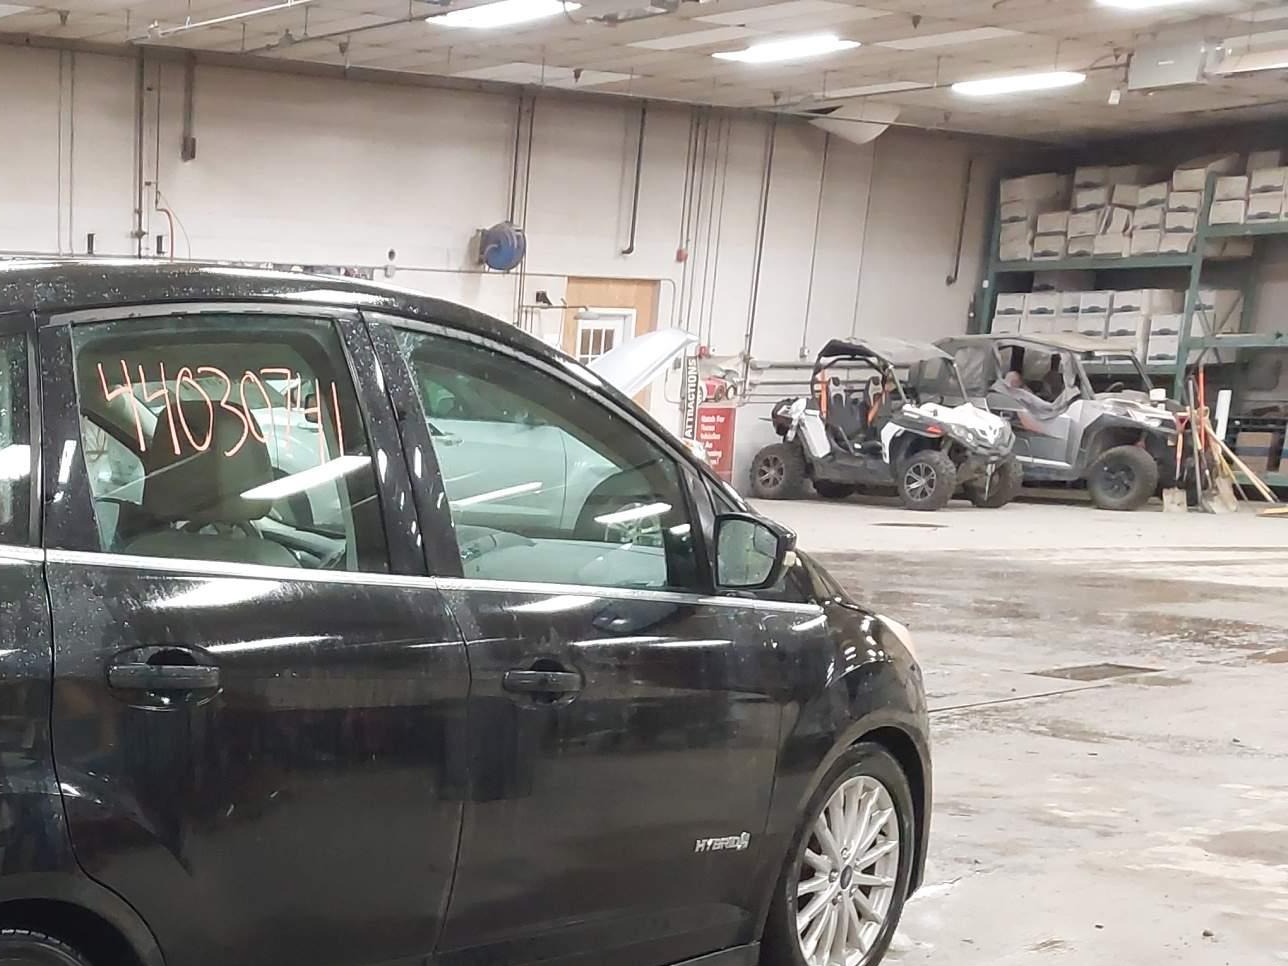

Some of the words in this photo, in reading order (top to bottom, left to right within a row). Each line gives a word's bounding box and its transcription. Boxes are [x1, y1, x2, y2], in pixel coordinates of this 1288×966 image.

[97, 359, 345, 465] 44030741
[684, 358, 698, 438] ATTRACTIONS
[695, 835, 741, 853] HYBRID
